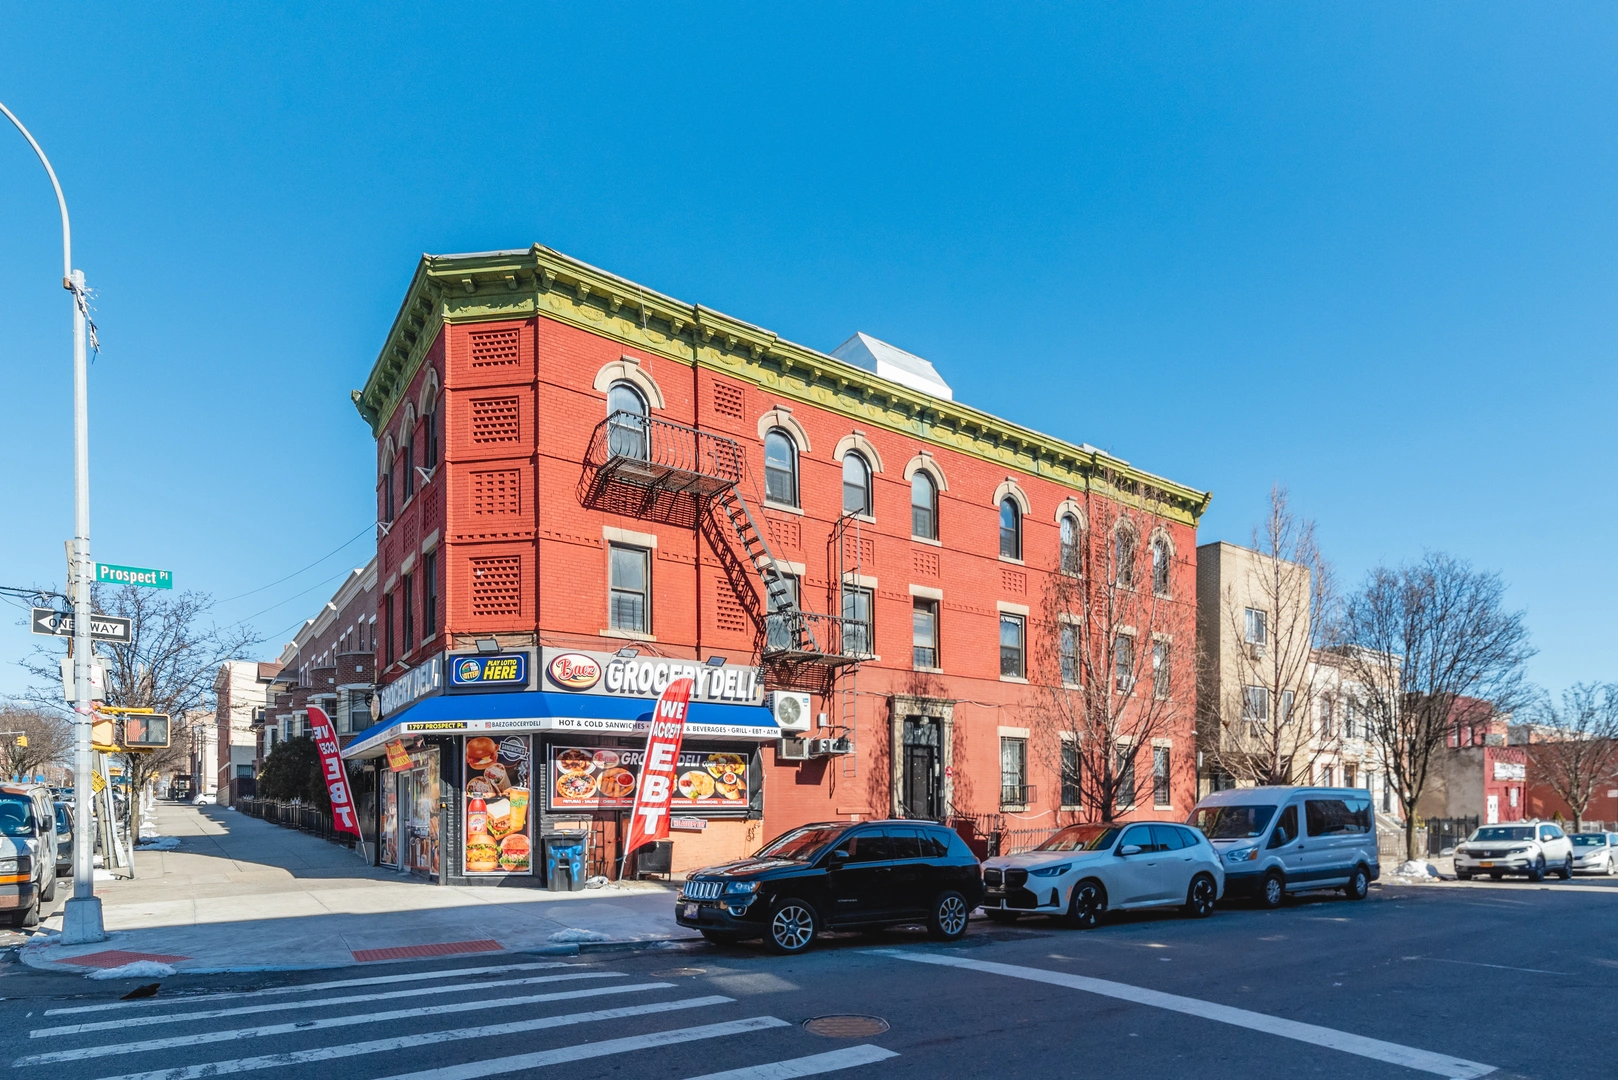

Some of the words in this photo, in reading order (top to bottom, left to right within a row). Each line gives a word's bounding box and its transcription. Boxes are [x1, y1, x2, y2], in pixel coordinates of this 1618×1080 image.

[100, 565, 157, 584] Prospect
[159, 571, 169, 580] Pl
[48, 618, 75, 629] ONE
[90, 622, 118, 634] WAY
[483, 665, 518, 680] HERE
[556, 658, 597, 681] Baez
[710, 668, 755, 699] DELI
[660, 700, 685, 720] WE
[653, 721, 682, 739] ACCEPT
[692, 725, 727, 733] BEVERAGES
[676, 754, 701, 767] DELI
[638, 742, 677, 835] EBT
